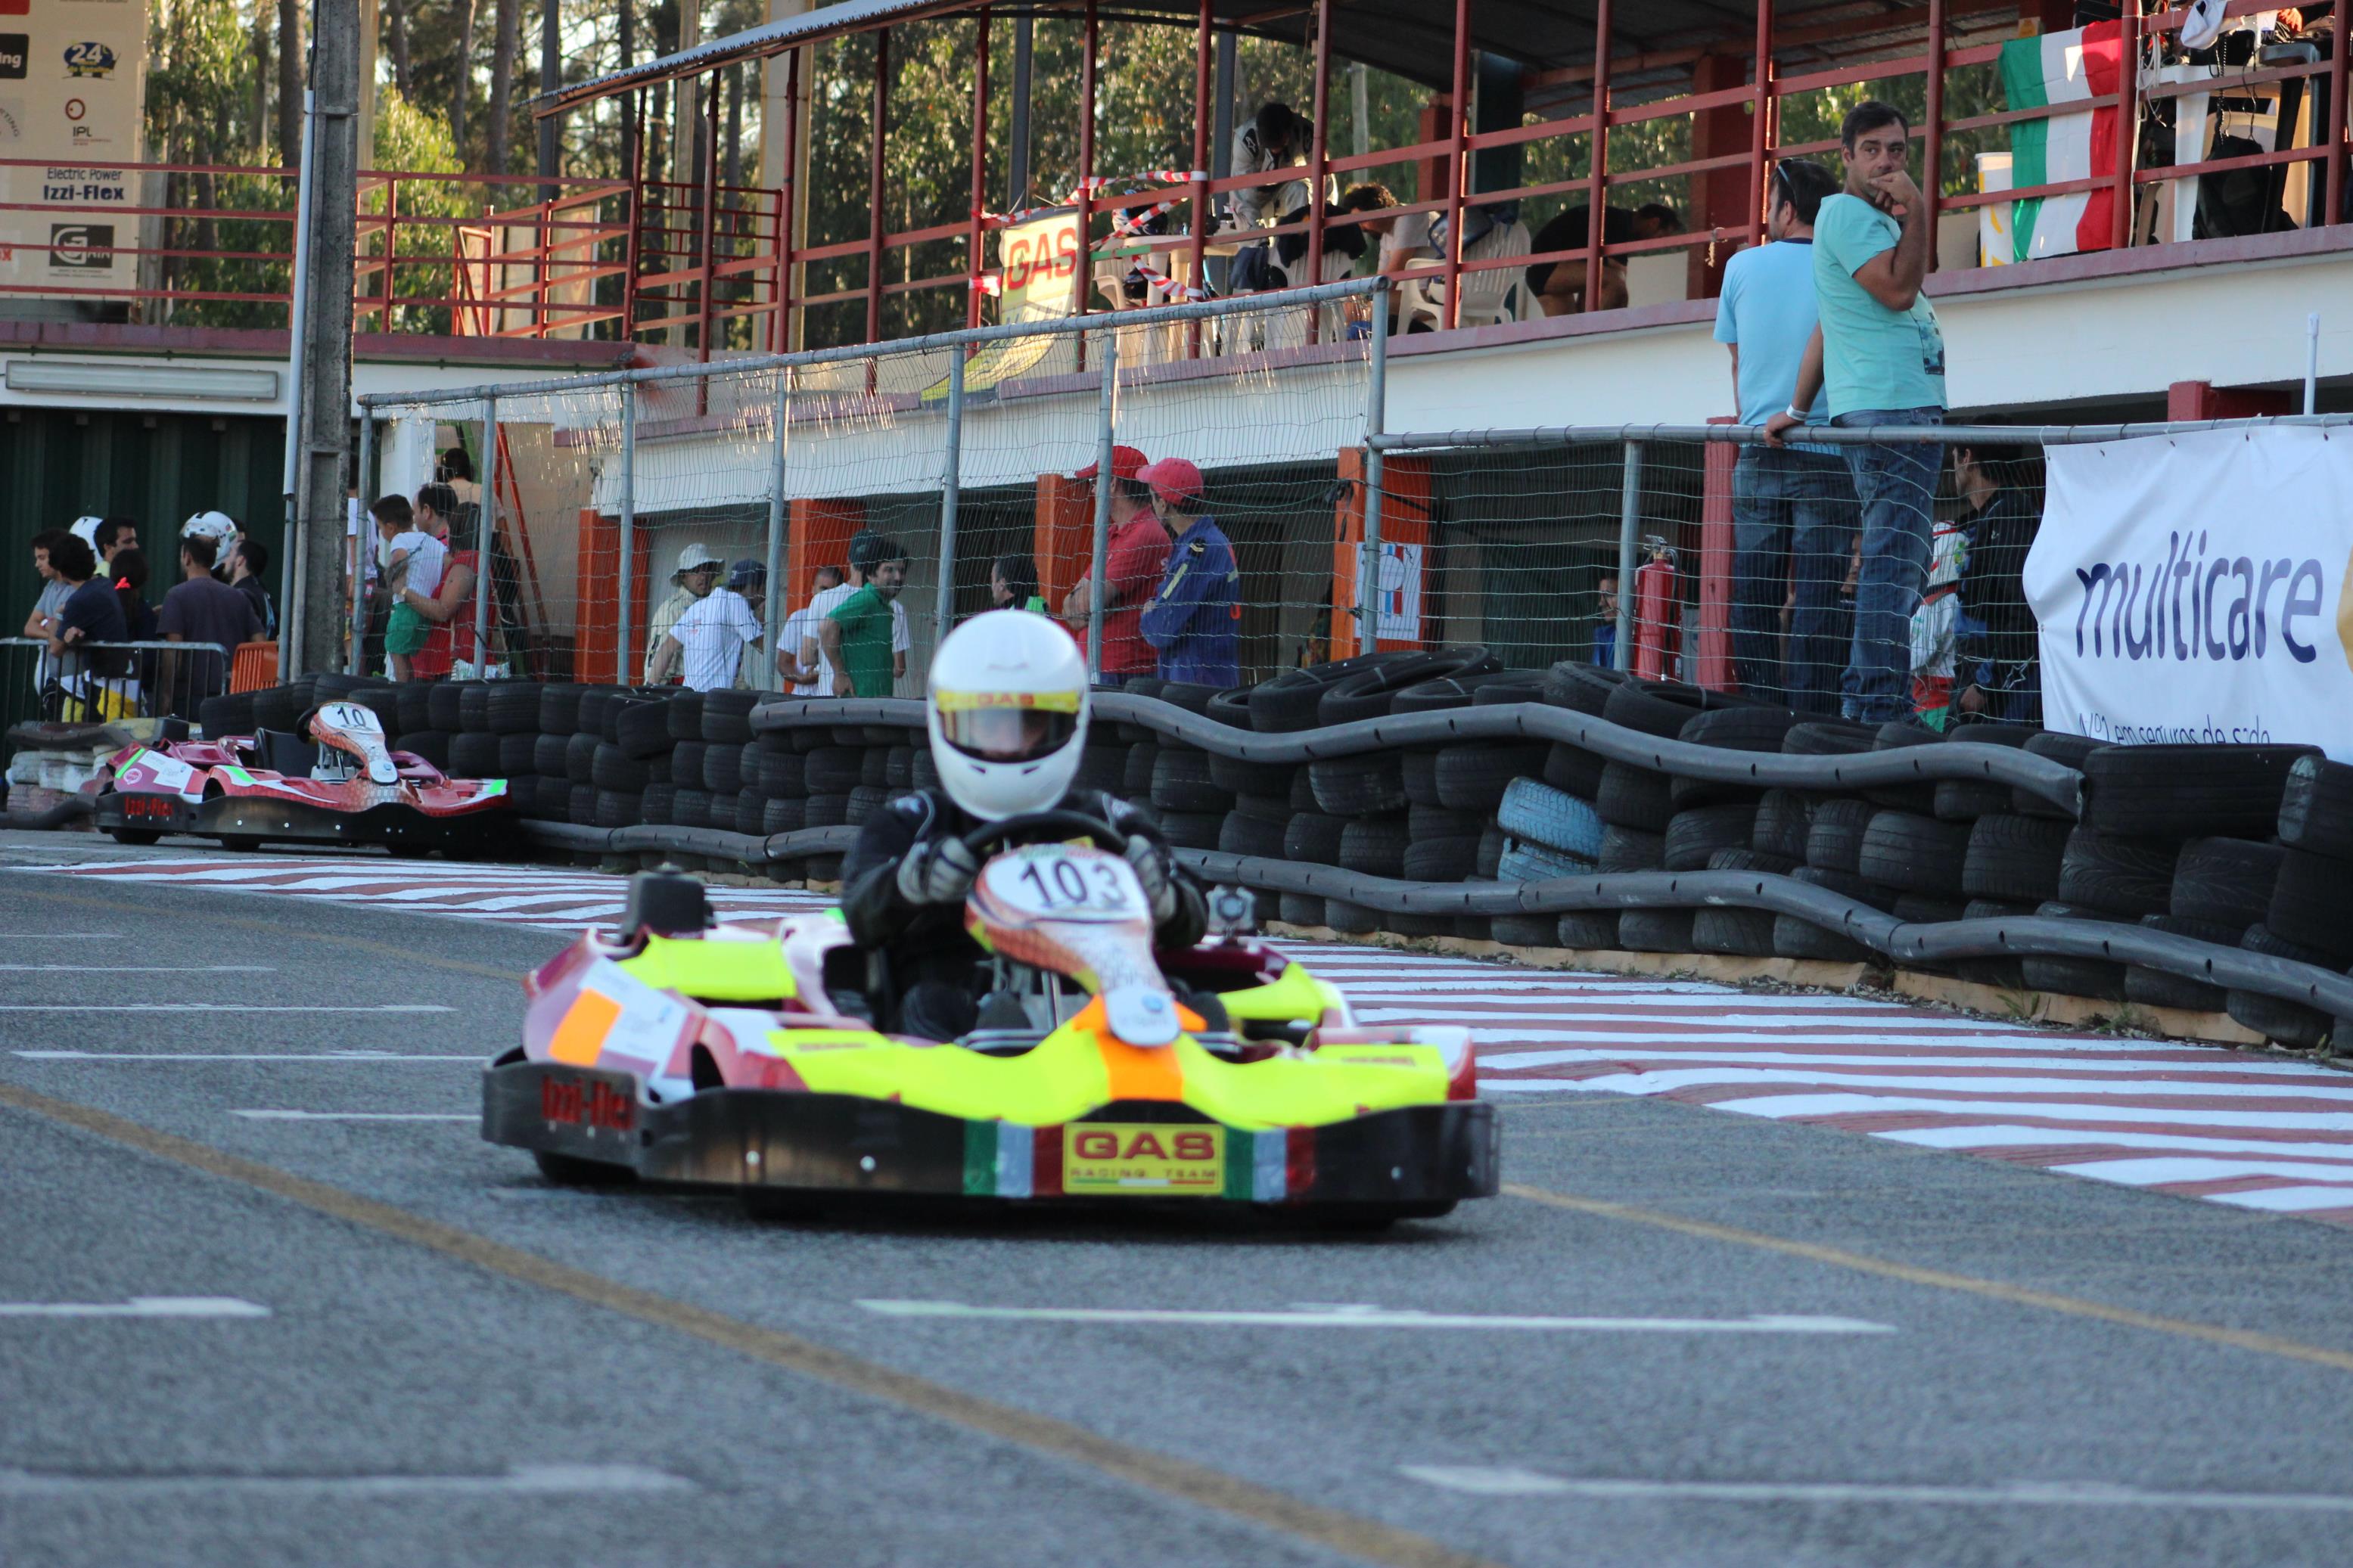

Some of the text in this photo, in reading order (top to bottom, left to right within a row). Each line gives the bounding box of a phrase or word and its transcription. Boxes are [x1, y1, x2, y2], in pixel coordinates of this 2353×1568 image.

[70, 44, 102, 63] 24
[73, 126, 92, 137] IPL
[48, 167, 123, 181] Electric Power
[44, 185, 125, 200] Izzi-Flex
[1007, 227, 1077, 290] GAS
[2075, 529, 2324, 664] multicare
[1020, 859, 1128, 908] 103
[1074, 1132, 1215, 1160] GAS
[1070, 1168, 1217, 1178] RACING TEAM
